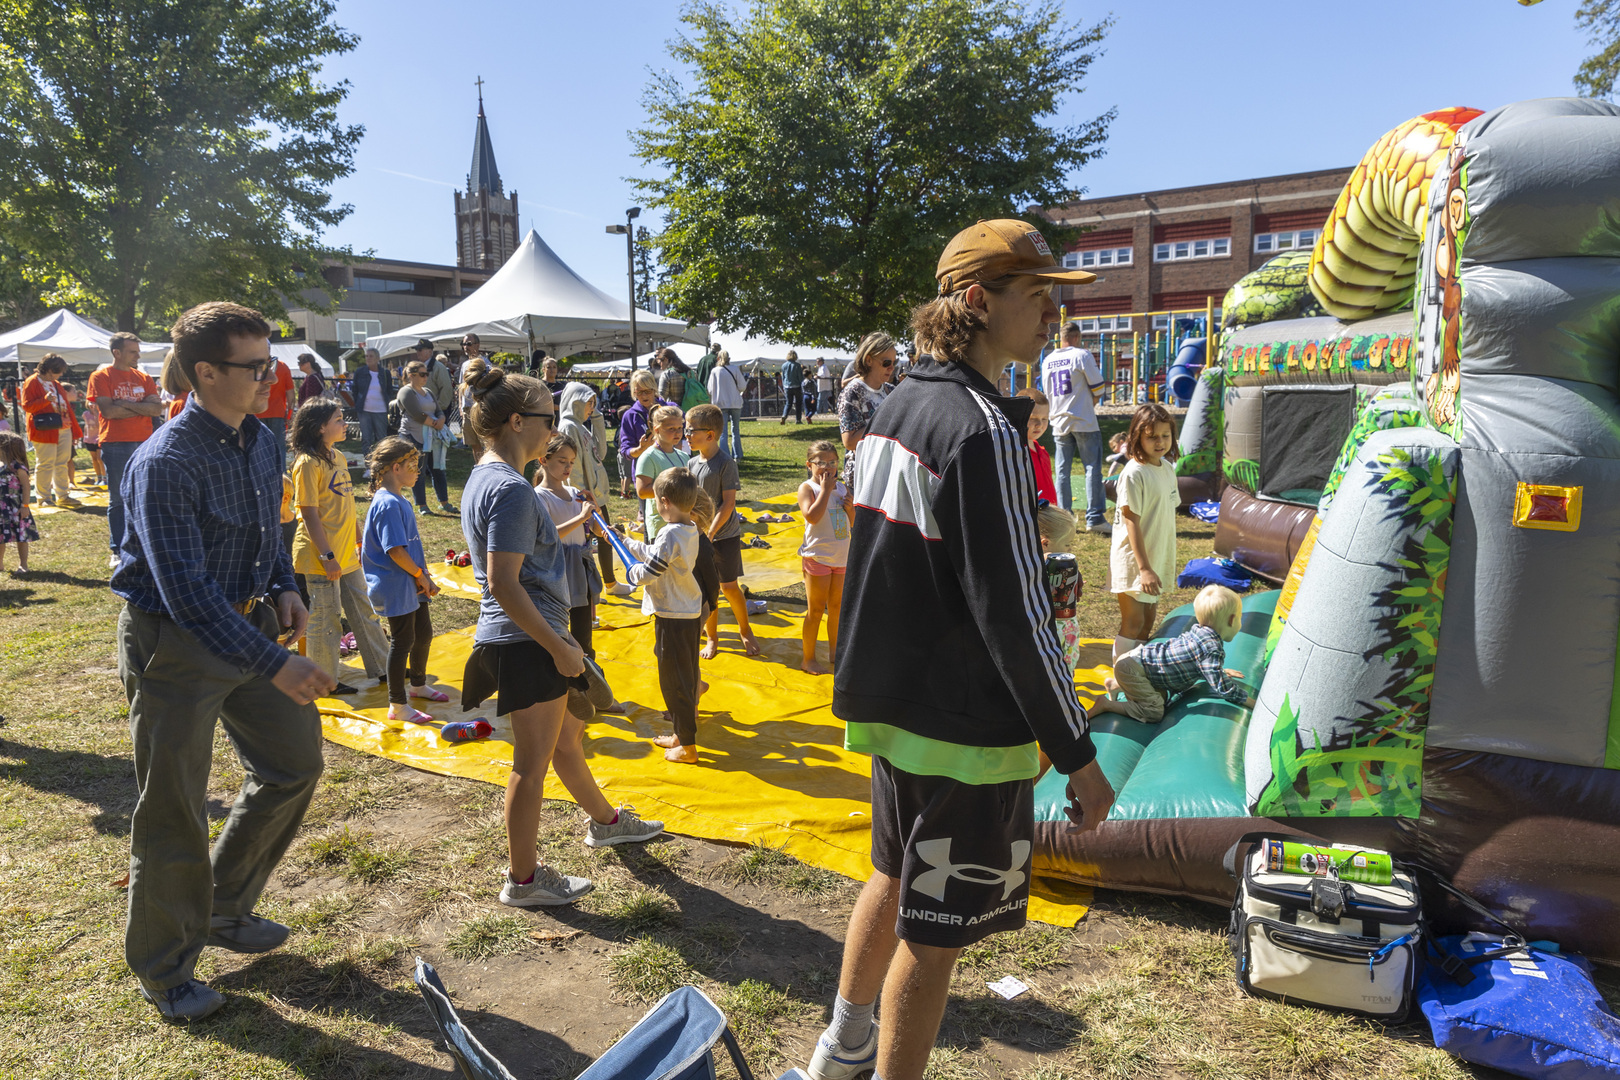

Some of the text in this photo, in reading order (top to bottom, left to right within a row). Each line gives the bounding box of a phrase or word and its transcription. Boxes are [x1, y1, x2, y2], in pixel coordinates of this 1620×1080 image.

[1029, 233, 1045, 244] LIO
[1047, 358, 1071, 370] JEFFERSON
[1231, 336, 1411, 372] THE LOST JU
[1051, 369, 1073, 397] 18
[900, 898, 1028, 926] UNDER ARMOUR
[822, 1038, 835, 1052] NIKE
